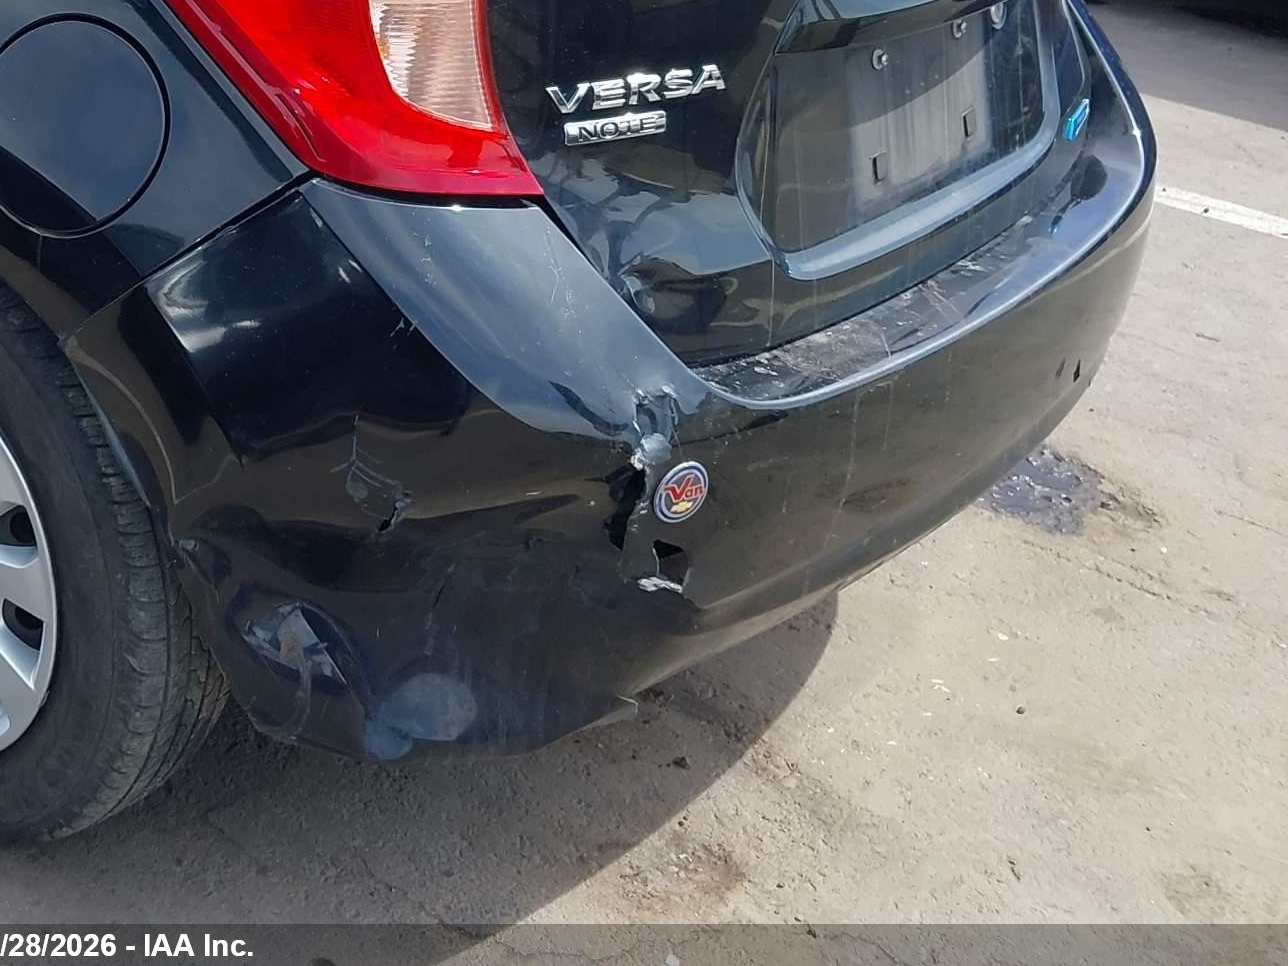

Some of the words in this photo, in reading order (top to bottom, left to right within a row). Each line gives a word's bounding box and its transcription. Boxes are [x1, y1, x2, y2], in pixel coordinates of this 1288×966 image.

[546, 64, 726, 114] VERSA
[577, 116, 657, 143] NOTE
[663, 474, 705, 503] Van
